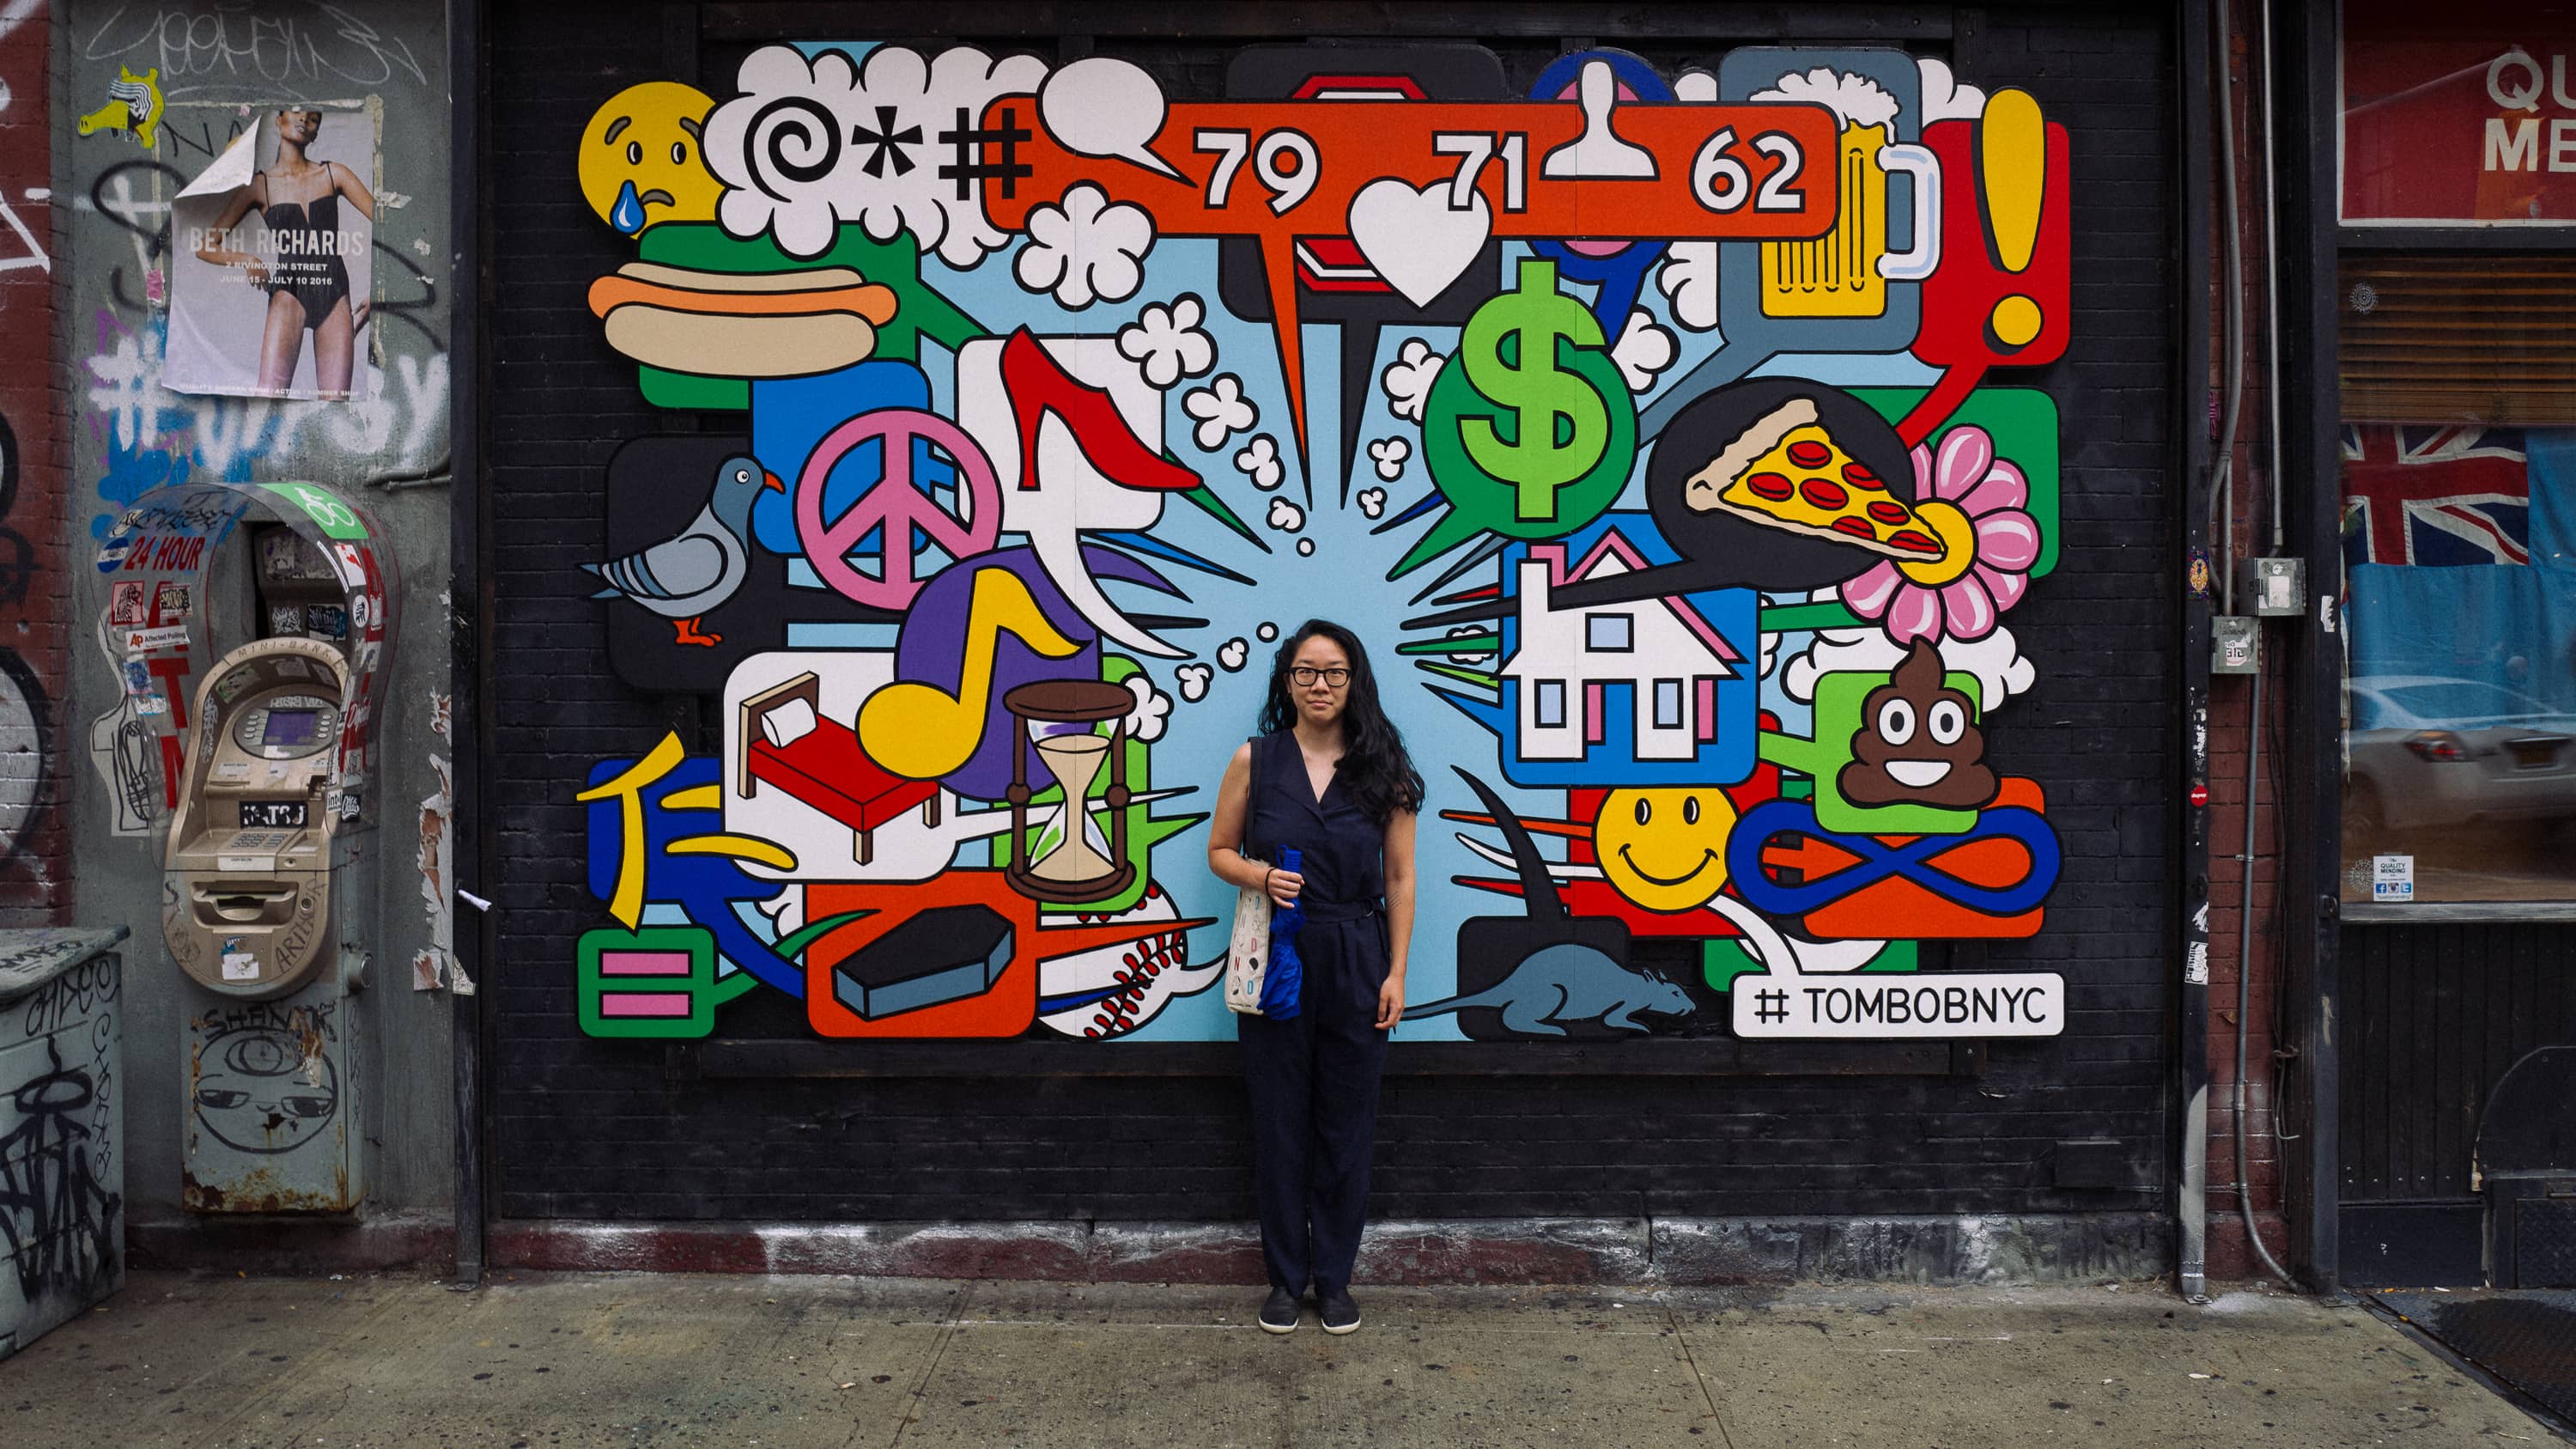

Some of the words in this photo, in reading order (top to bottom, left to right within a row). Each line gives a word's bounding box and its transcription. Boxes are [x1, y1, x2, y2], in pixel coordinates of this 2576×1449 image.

[1194, 126, 1321, 218] 79
[1432, 131, 1528, 214] 71
[1688, 125, 1806, 214] 62
[189, 226, 246, 253] BETH
[258, 228, 364, 257] RICHARDS
[220, 275, 246, 283] JUNE
[268, 276, 293, 284] JULY
[295, 277, 307, 285] 10
[310, 277, 332, 285] 2016
[234, 261, 288, 271] RIVINGTON
[290, 263, 328, 271] STREET
[124, 536, 156, 570] 24
[153, 536, 206, 571] HOUR
[1802, 987, 2047, 1024] TOMBOBNYC
